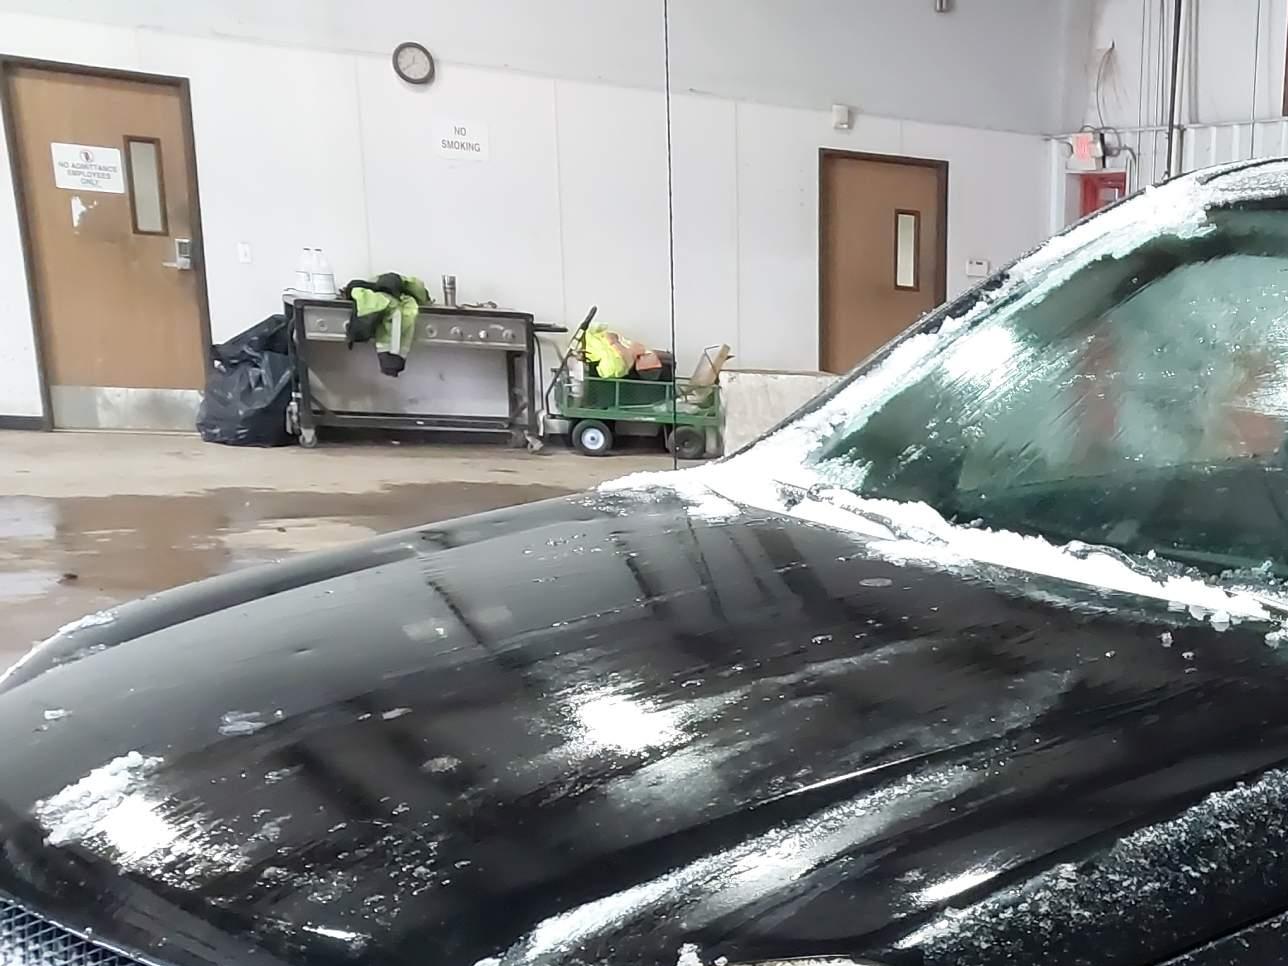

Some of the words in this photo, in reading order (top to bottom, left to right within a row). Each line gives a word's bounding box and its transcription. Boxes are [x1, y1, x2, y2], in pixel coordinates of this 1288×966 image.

[454, 126, 467, 137] NO
[441, 139, 481, 153] SMOKING
[58, 161, 69, 169] NO
